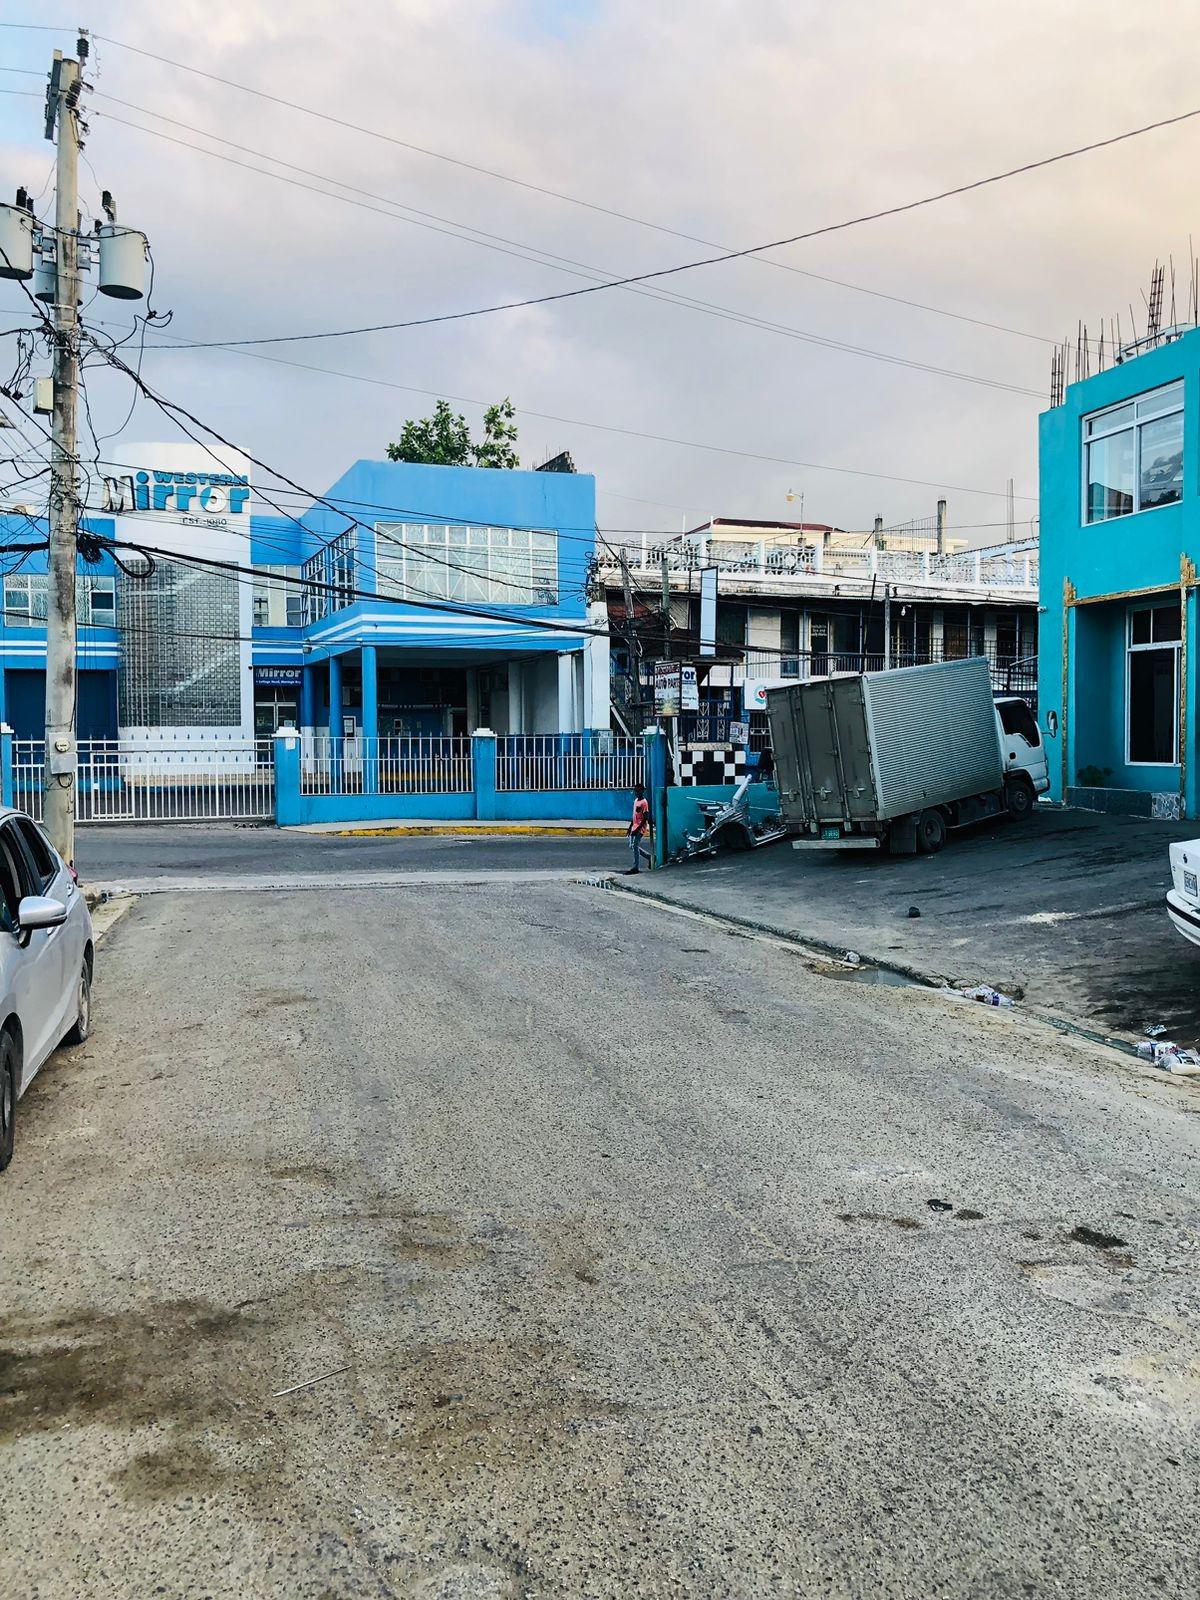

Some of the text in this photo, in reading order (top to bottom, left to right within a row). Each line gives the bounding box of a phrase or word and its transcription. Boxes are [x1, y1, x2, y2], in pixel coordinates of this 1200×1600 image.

[153, 470, 248, 486] WESTERN
[103, 471, 250, 513] Mirror
[256, 668, 301, 677] Mirror
